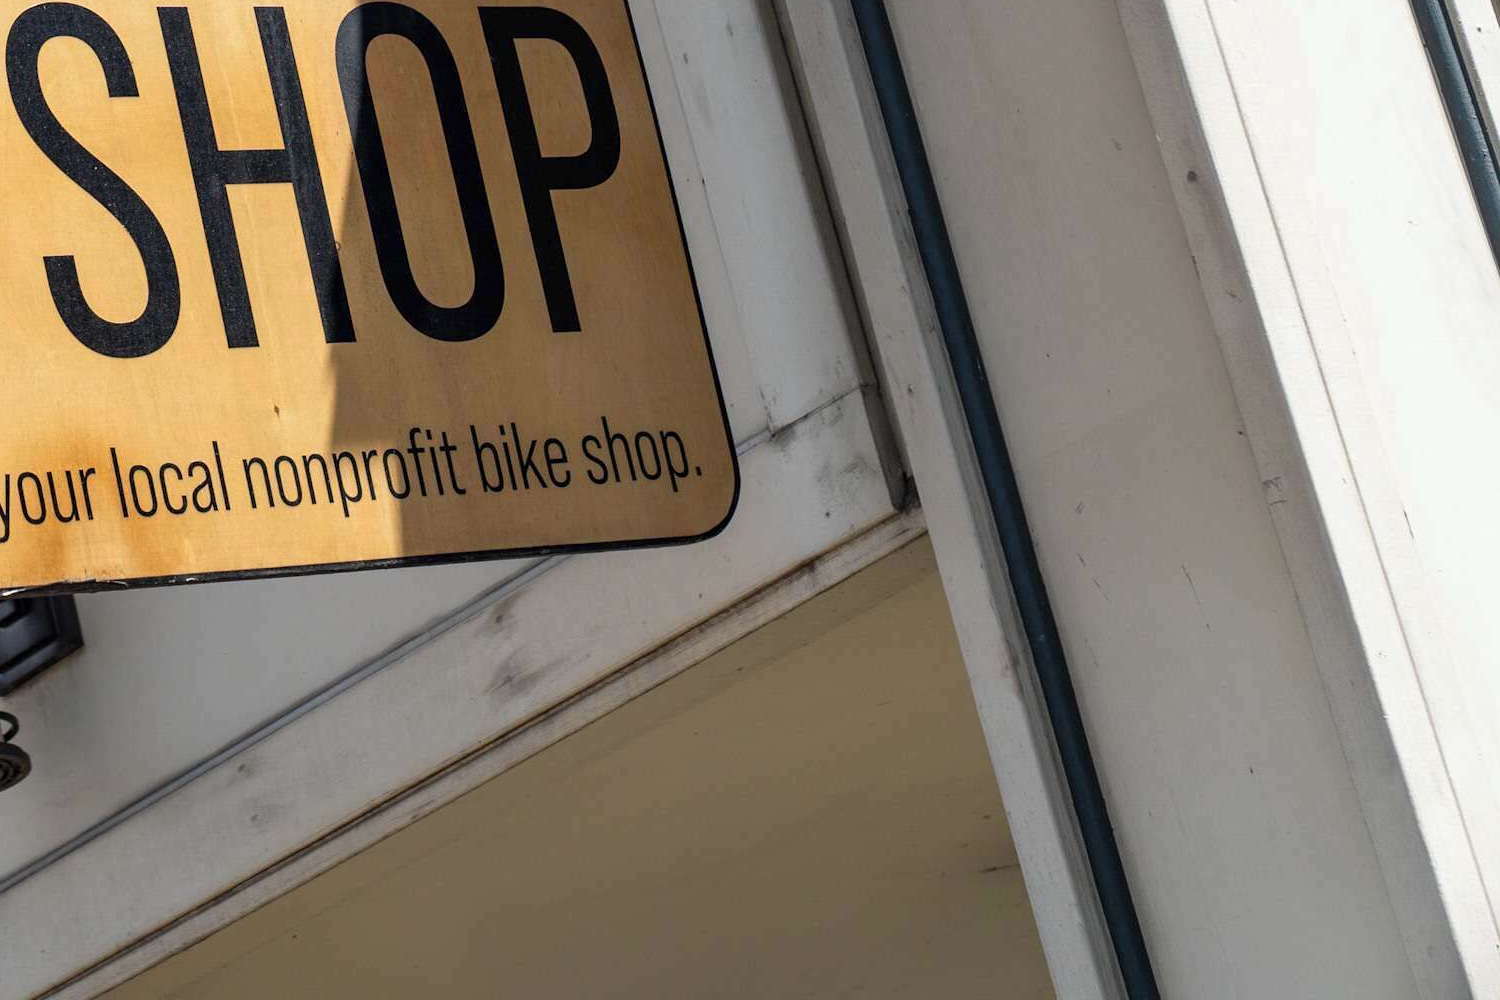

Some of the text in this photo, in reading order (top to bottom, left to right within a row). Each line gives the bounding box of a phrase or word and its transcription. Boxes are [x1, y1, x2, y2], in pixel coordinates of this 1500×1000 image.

[6, 1, 621, 358] SHOP
[110, 440, 230, 518] local
[242, 426, 467, 518] nonprofit
[469, 423, 572, 494] bike
[580, 415, 704, 494] shop.
